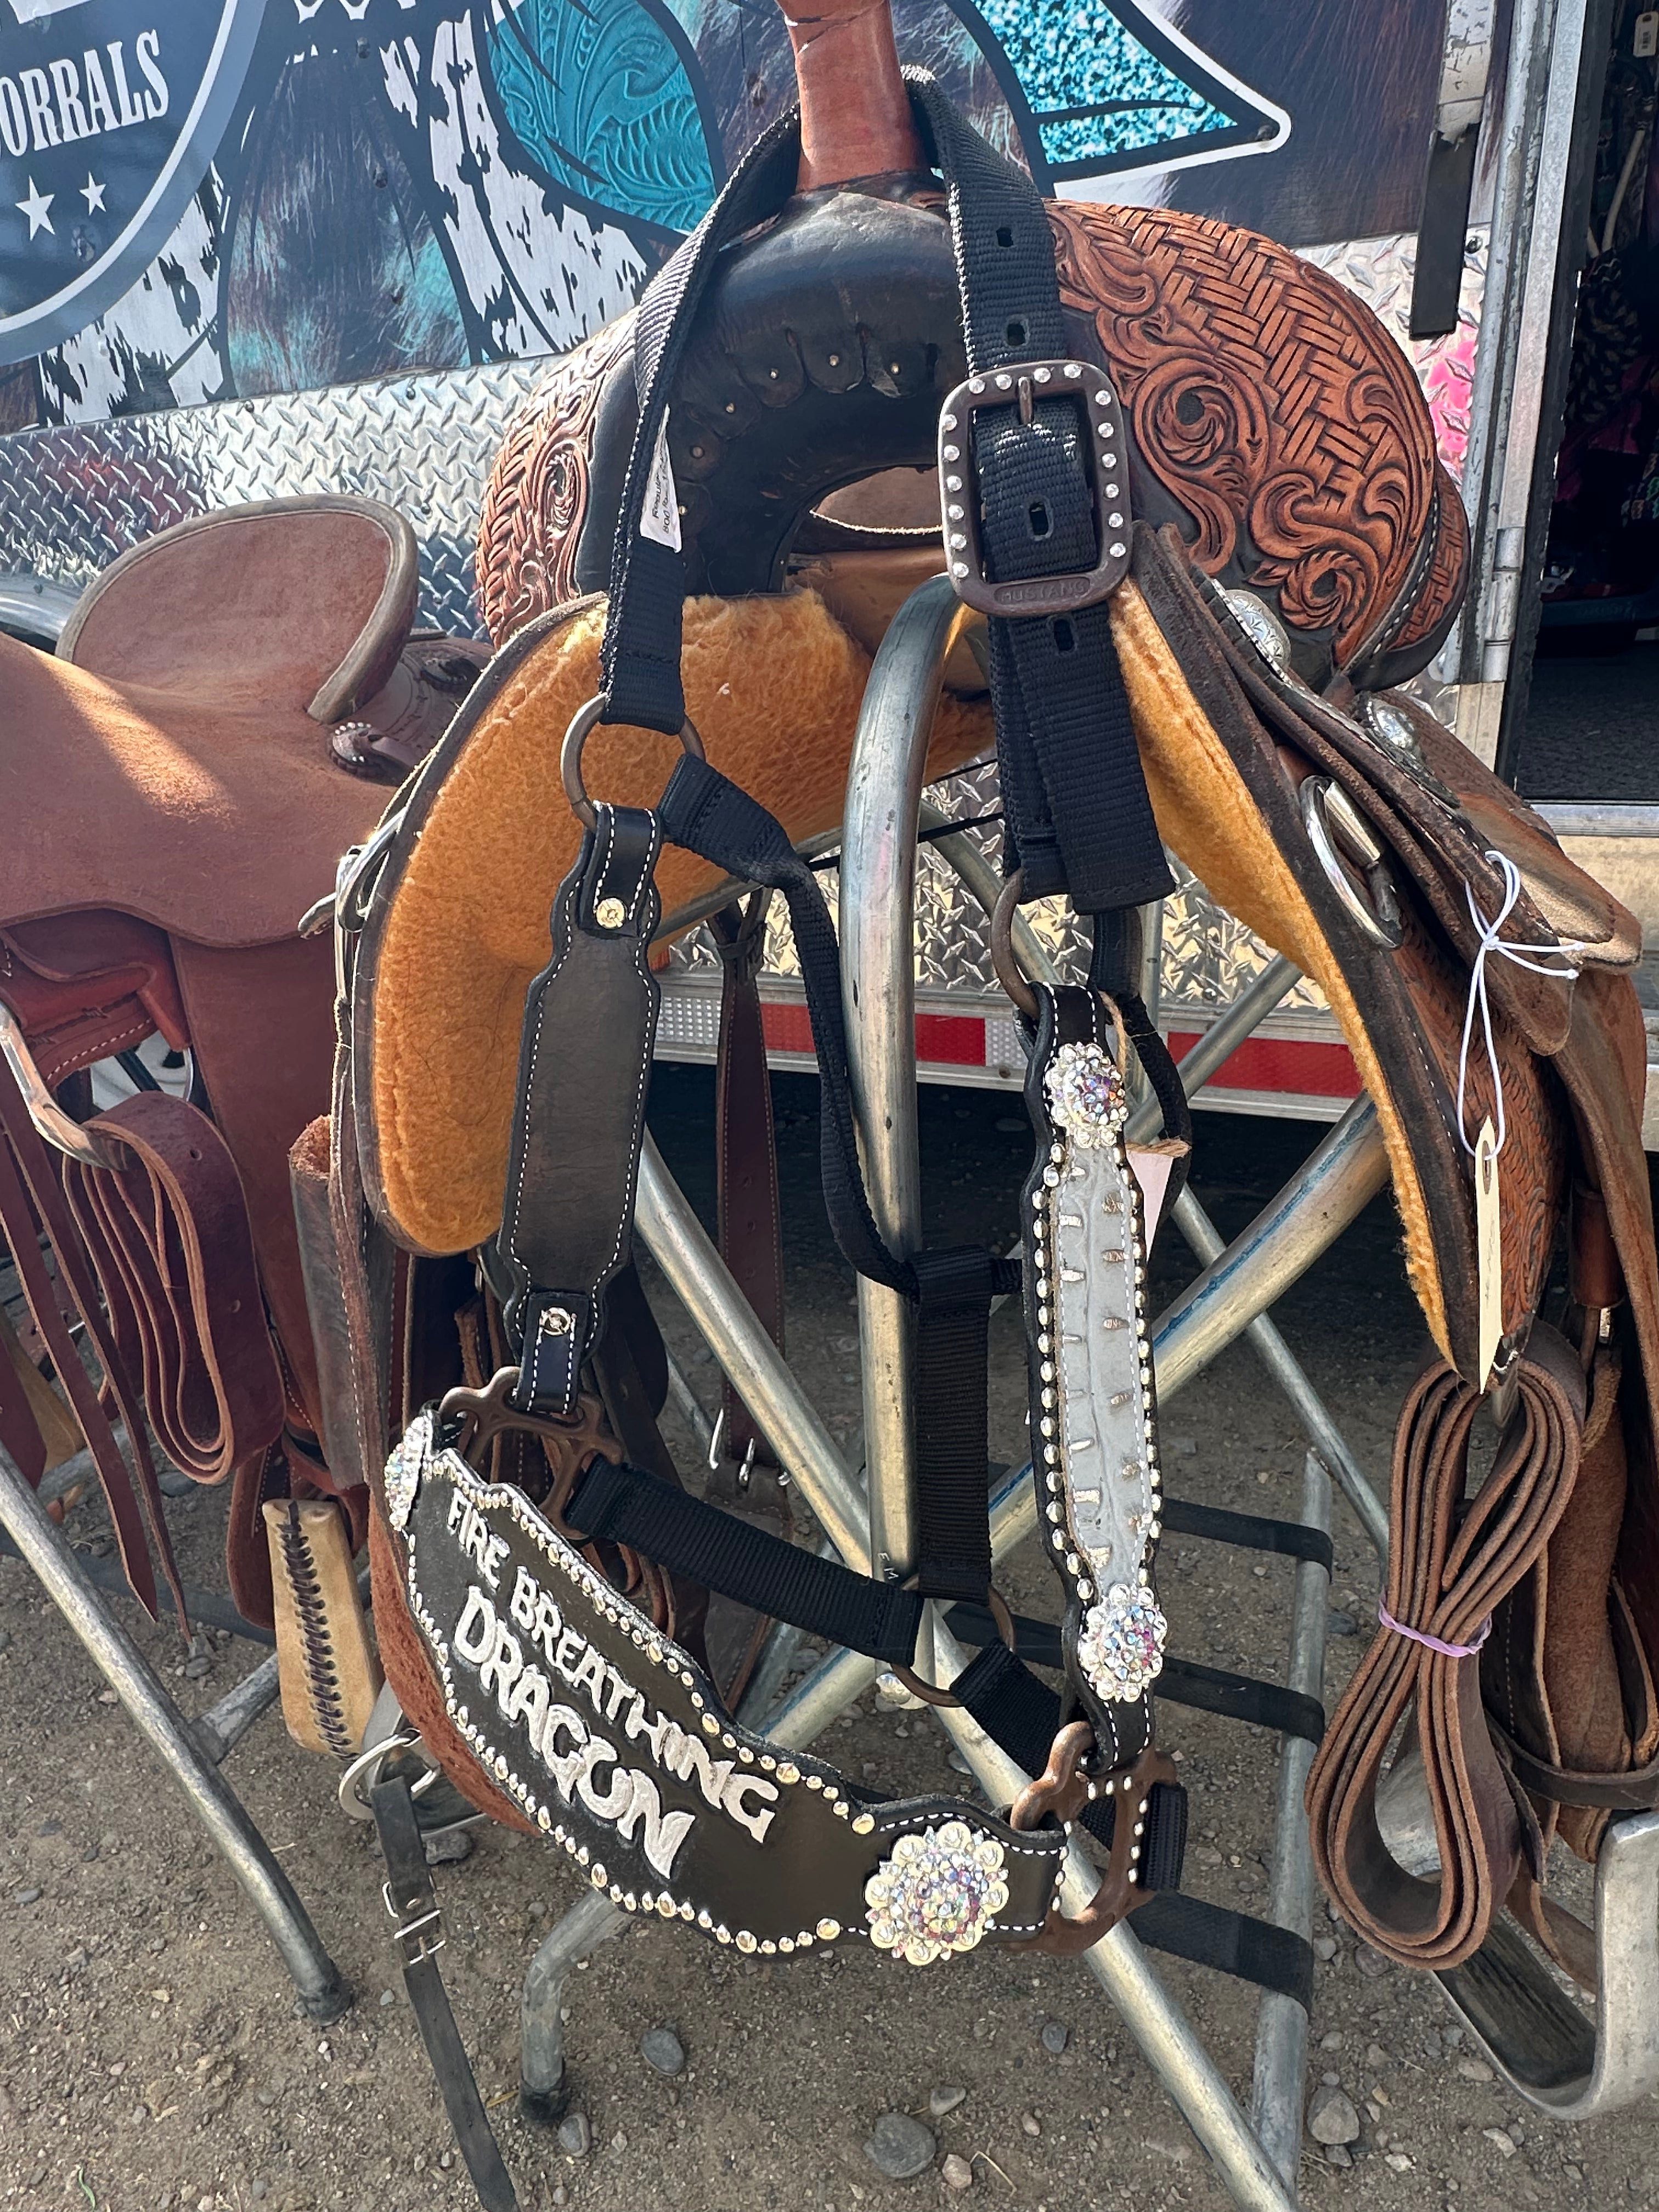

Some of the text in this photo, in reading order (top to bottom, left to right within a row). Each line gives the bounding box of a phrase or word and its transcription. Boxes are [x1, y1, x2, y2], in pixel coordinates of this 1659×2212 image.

[0, 29, 169, 157] ORRALS
[1000, 579, 1085, 603] MUSTANG
[447, 1487, 779, 1843] FIRE BREATHING
[454, 1584, 696, 1879] DRAGON
